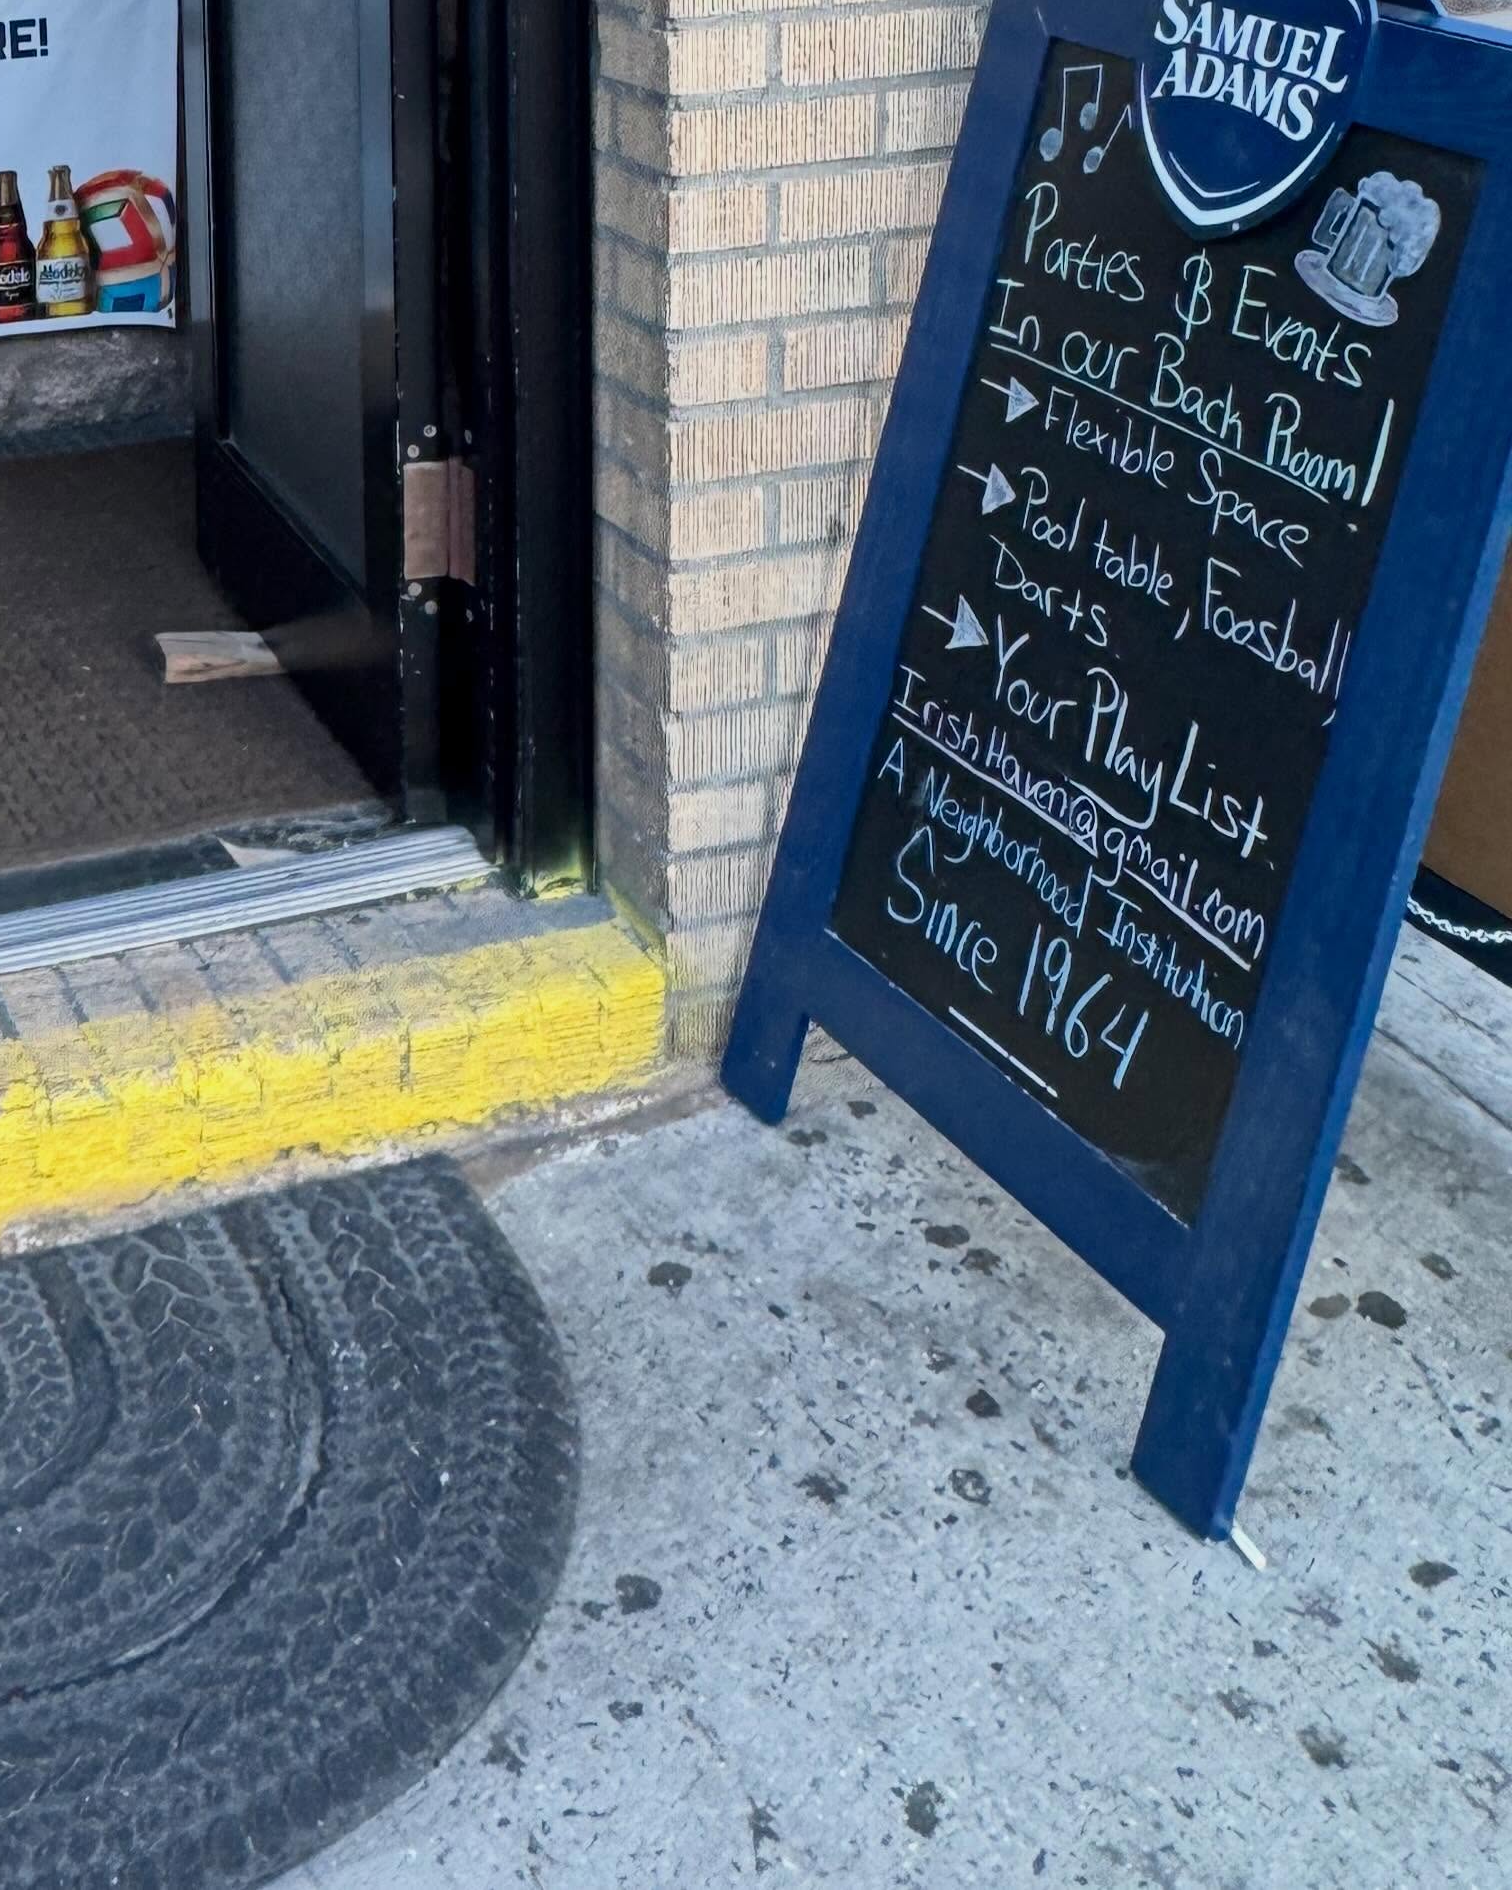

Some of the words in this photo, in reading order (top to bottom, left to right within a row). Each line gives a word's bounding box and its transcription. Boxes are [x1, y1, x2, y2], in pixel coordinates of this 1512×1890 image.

[1149, 46, 1320, 142] ADAMS
[989, 277, 1040, 351] In
[1061, 330, 1140, 390] our
[1149, 332, 1242, 451] Back
[1024, 182, 1145, 301] Parties
[1231, 264, 1373, 389] Events
[1020, 466, 1086, 553] Pool
[1045, 385, 1176, 489] Flexible
[1187, 447, 1310, 568] Space
[989, 533, 1108, 647] Darts
[995, 613, 1078, 740] Your
[877, 737, 905, 795] A
[926, 766, 1095, 939] Neighborhood
[1098, 889, 1245, 1051] Institution
[887, 825, 999, 994] Since
[1018, 923, 1150, 1090] 1964
